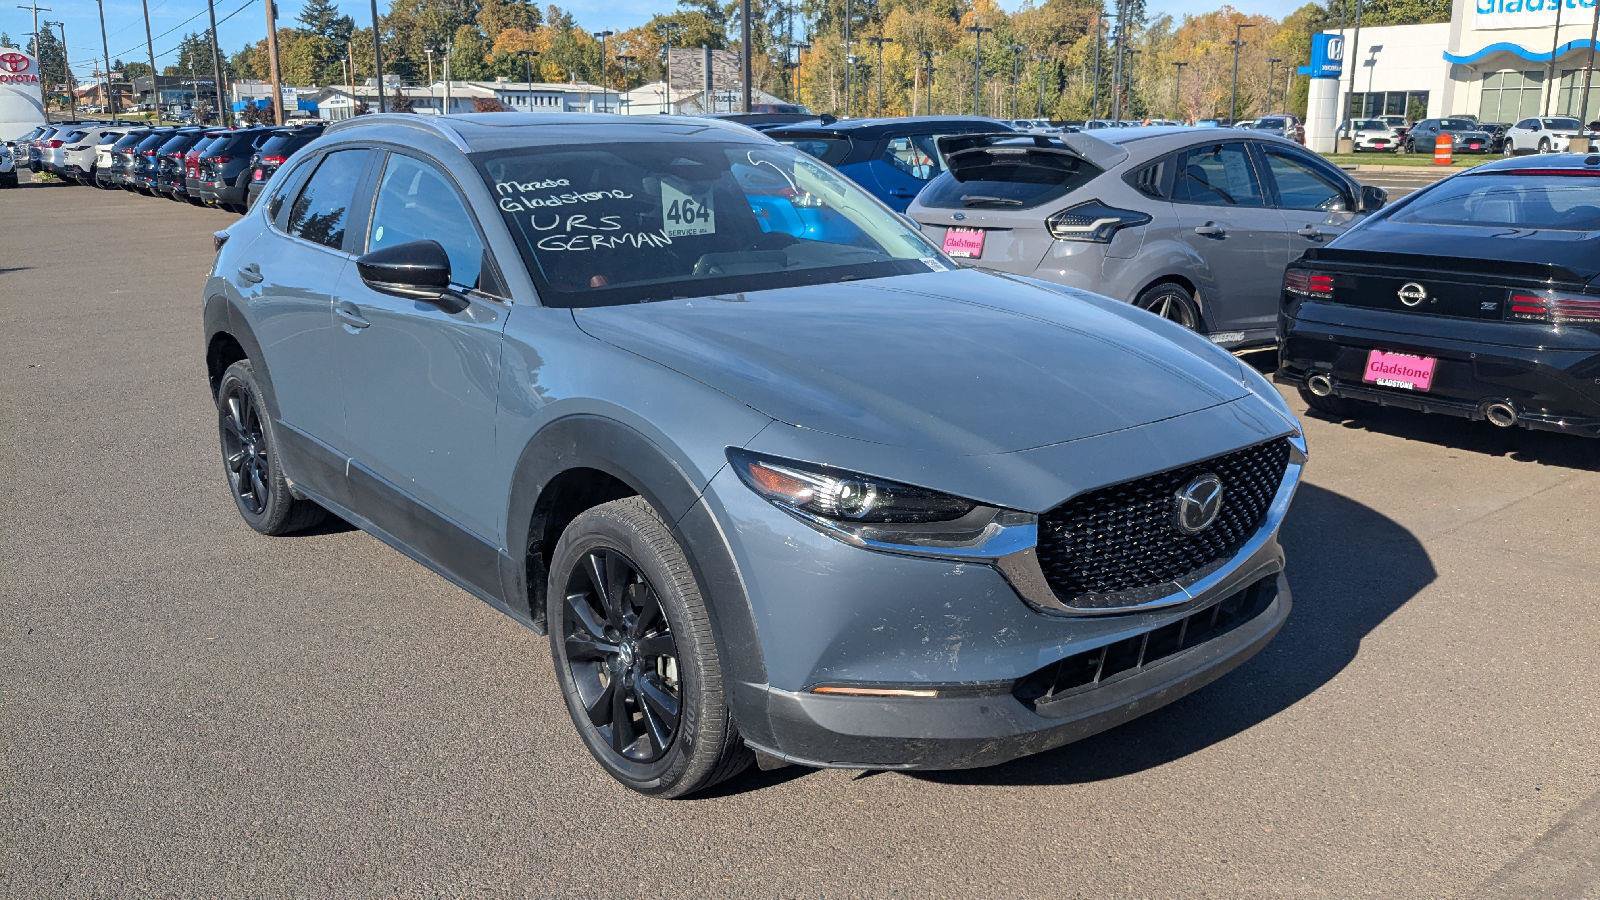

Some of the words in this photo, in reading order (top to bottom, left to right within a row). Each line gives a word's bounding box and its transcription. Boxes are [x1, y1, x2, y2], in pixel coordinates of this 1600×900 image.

[495, 178, 570, 196] Mazda
[499, 189, 633, 212] Gladstone
[666, 199, 710, 225] 464
[537, 228, 673, 251] GERMAN
[668, 228, 697, 237] SERVICE
[946, 238, 981, 249] Gladstone
[1370, 361, 1430, 379] Gladstone
[1376, 378, 1414, 390] GLADSTONE
